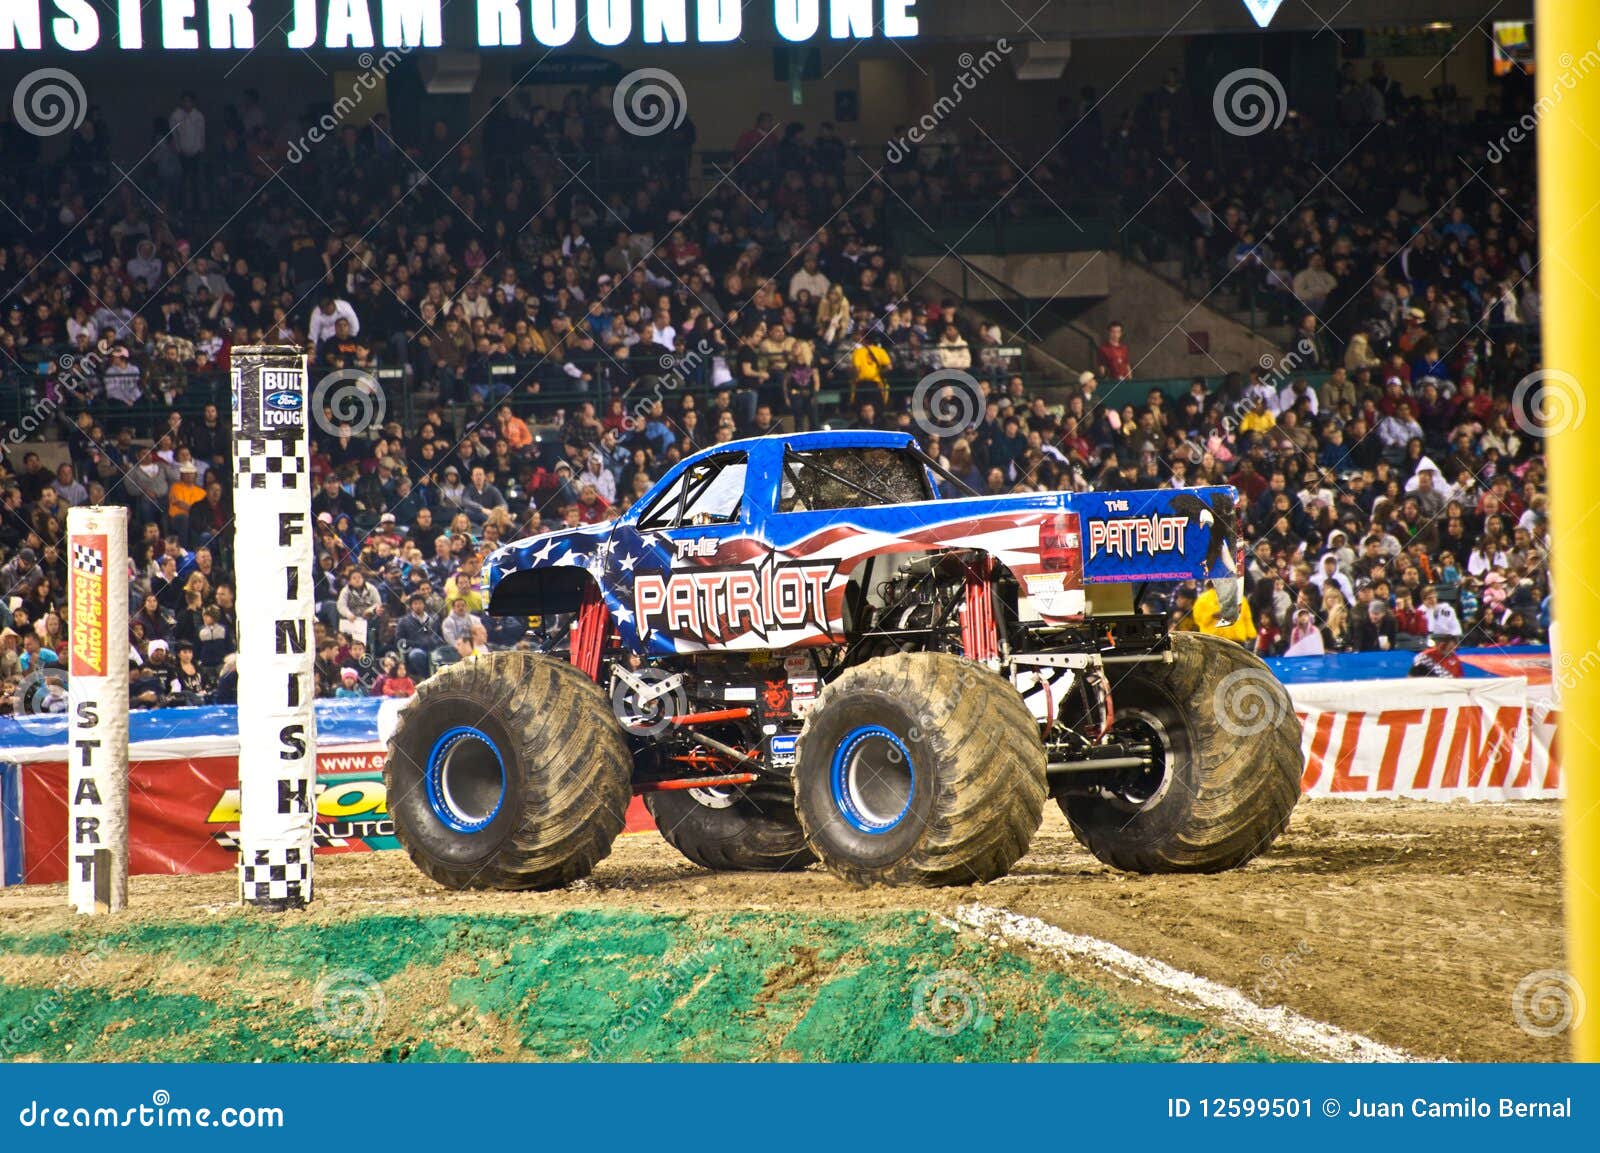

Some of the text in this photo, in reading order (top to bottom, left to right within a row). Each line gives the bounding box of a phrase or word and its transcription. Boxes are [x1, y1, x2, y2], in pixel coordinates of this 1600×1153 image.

[287, 0, 443, 49] JAM
[476, 0, 742, 47] ROUND
[774, 0, 919, 41] ONE
[1089, 513, 1190, 559] PATRIOT
[1104, 500, 1129, 512] THE
[674, 537, 720, 560] THE
[74, 575, 88, 660] Advance
[87, 580, 103, 673] Auto Parts
[634, 558, 836, 642] PATRIOT
[275, 512, 309, 814] FINISH
[74, 701, 103, 883] START
